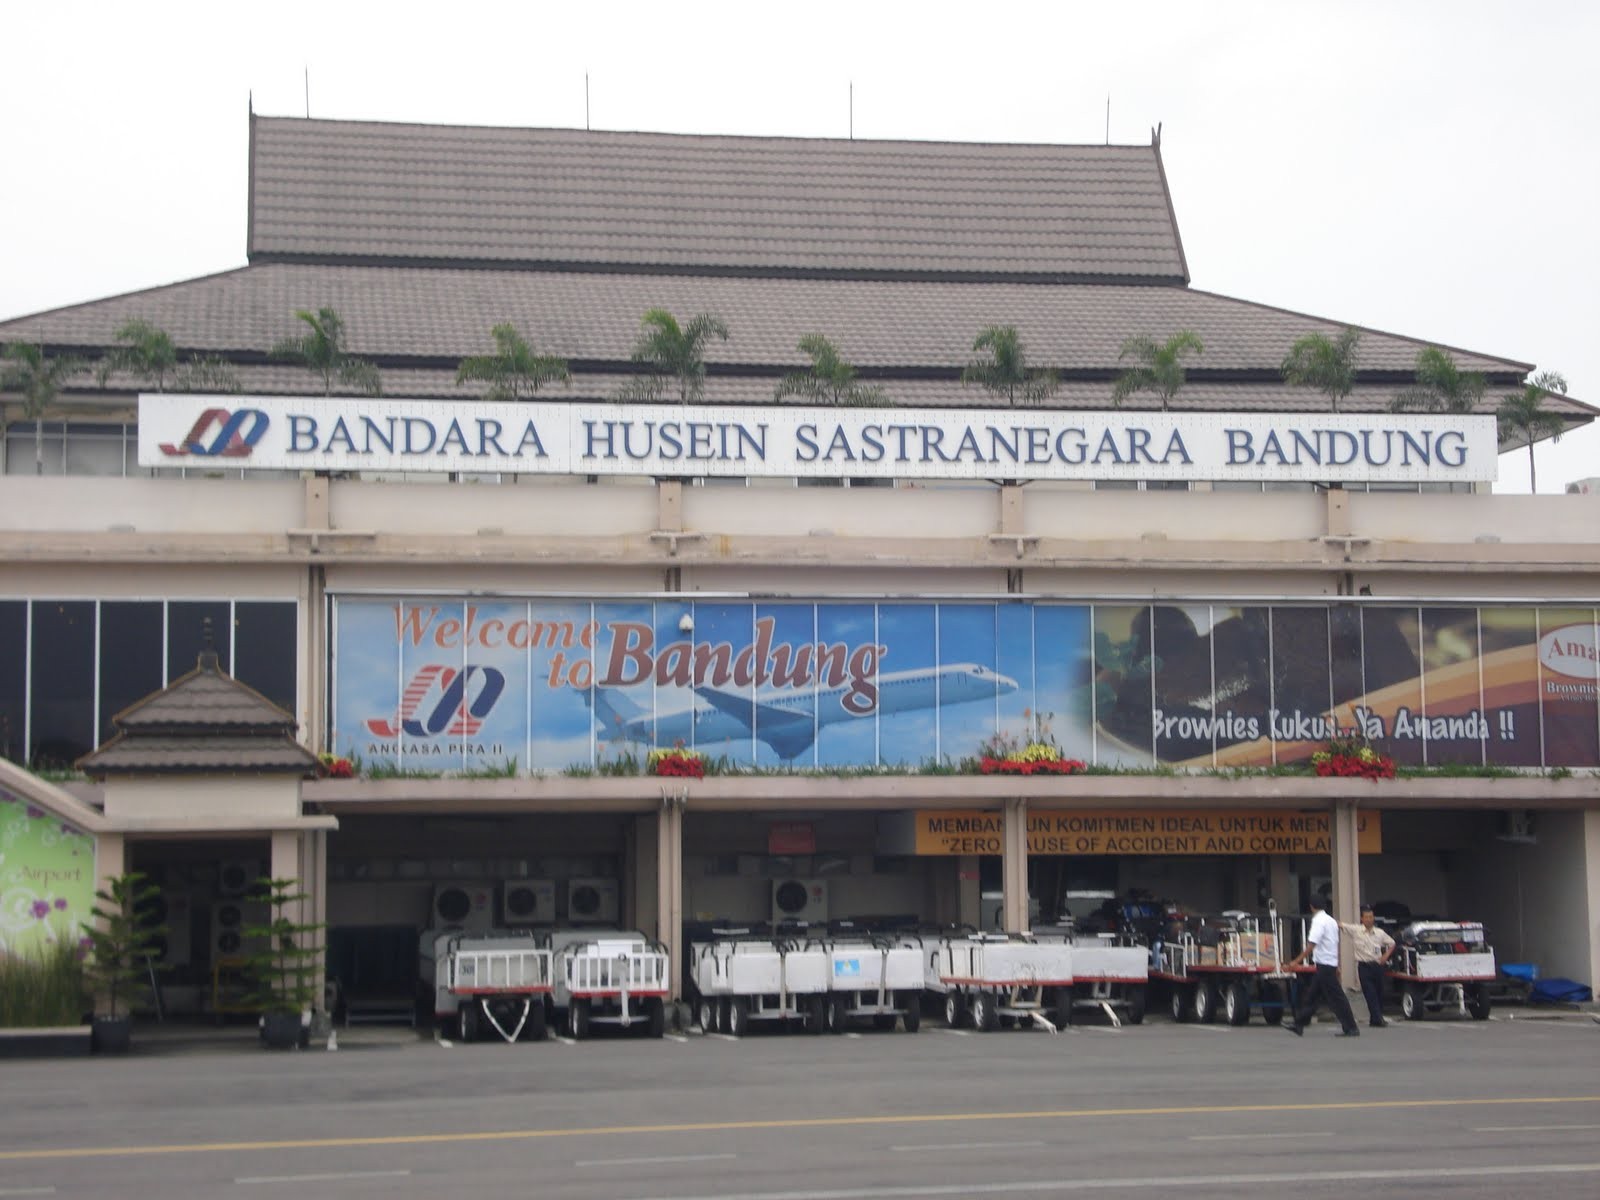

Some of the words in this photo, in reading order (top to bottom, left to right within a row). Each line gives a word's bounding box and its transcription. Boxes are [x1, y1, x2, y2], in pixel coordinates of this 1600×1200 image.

[287, 414, 549, 456] BANDARA
[582, 420, 767, 459] HUSEIN
[795, 424, 1193, 465] SASTRANEGARA
[1225, 427, 1468, 467] BANDUNG
[394, 606, 600, 649] Welcome
[598, 615, 887, 716] Bandung
[1548, 637, 1600, 664] Ama
[547, 651, 594, 689] to
[1153, 708, 1260, 740] Brownies
[1394, 709, 1490, 740] Ananda
[1057, 817, 1155, 833] KOMITMEN
[1161, 817, 1214, 833] IDEAL
[1220, 817, 1285, 833] UNTUK
[1076, 837, 1100, 851] OF
[1106, 837, 1200, 851] ACCIDENT
[1205, 837, 1244, 851] AND
